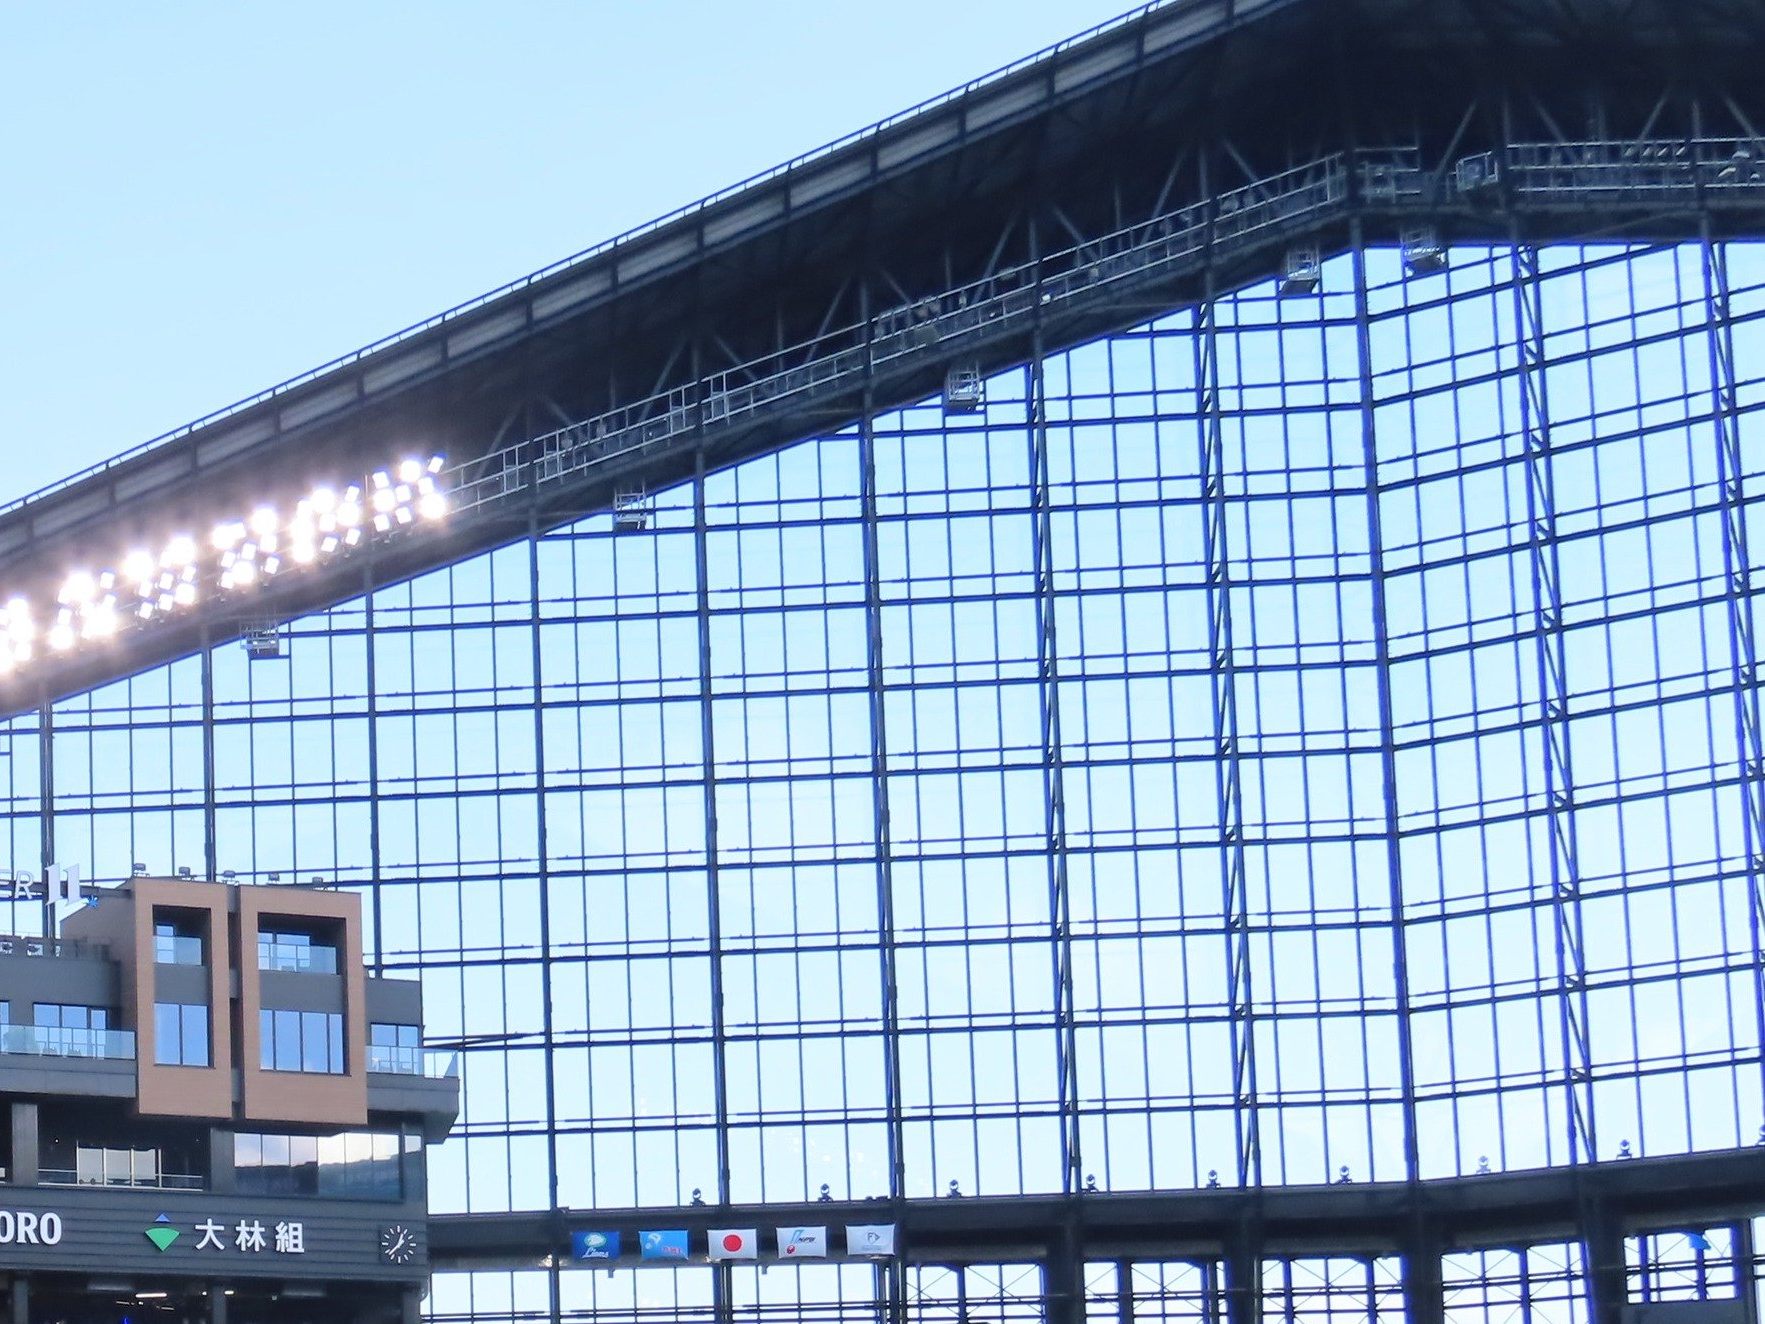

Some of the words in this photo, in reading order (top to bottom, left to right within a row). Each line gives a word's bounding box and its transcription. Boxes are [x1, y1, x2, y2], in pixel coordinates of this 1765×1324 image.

[44, 862, 83, 907] 11
[194, 1218, 306, 1254] 大林組
